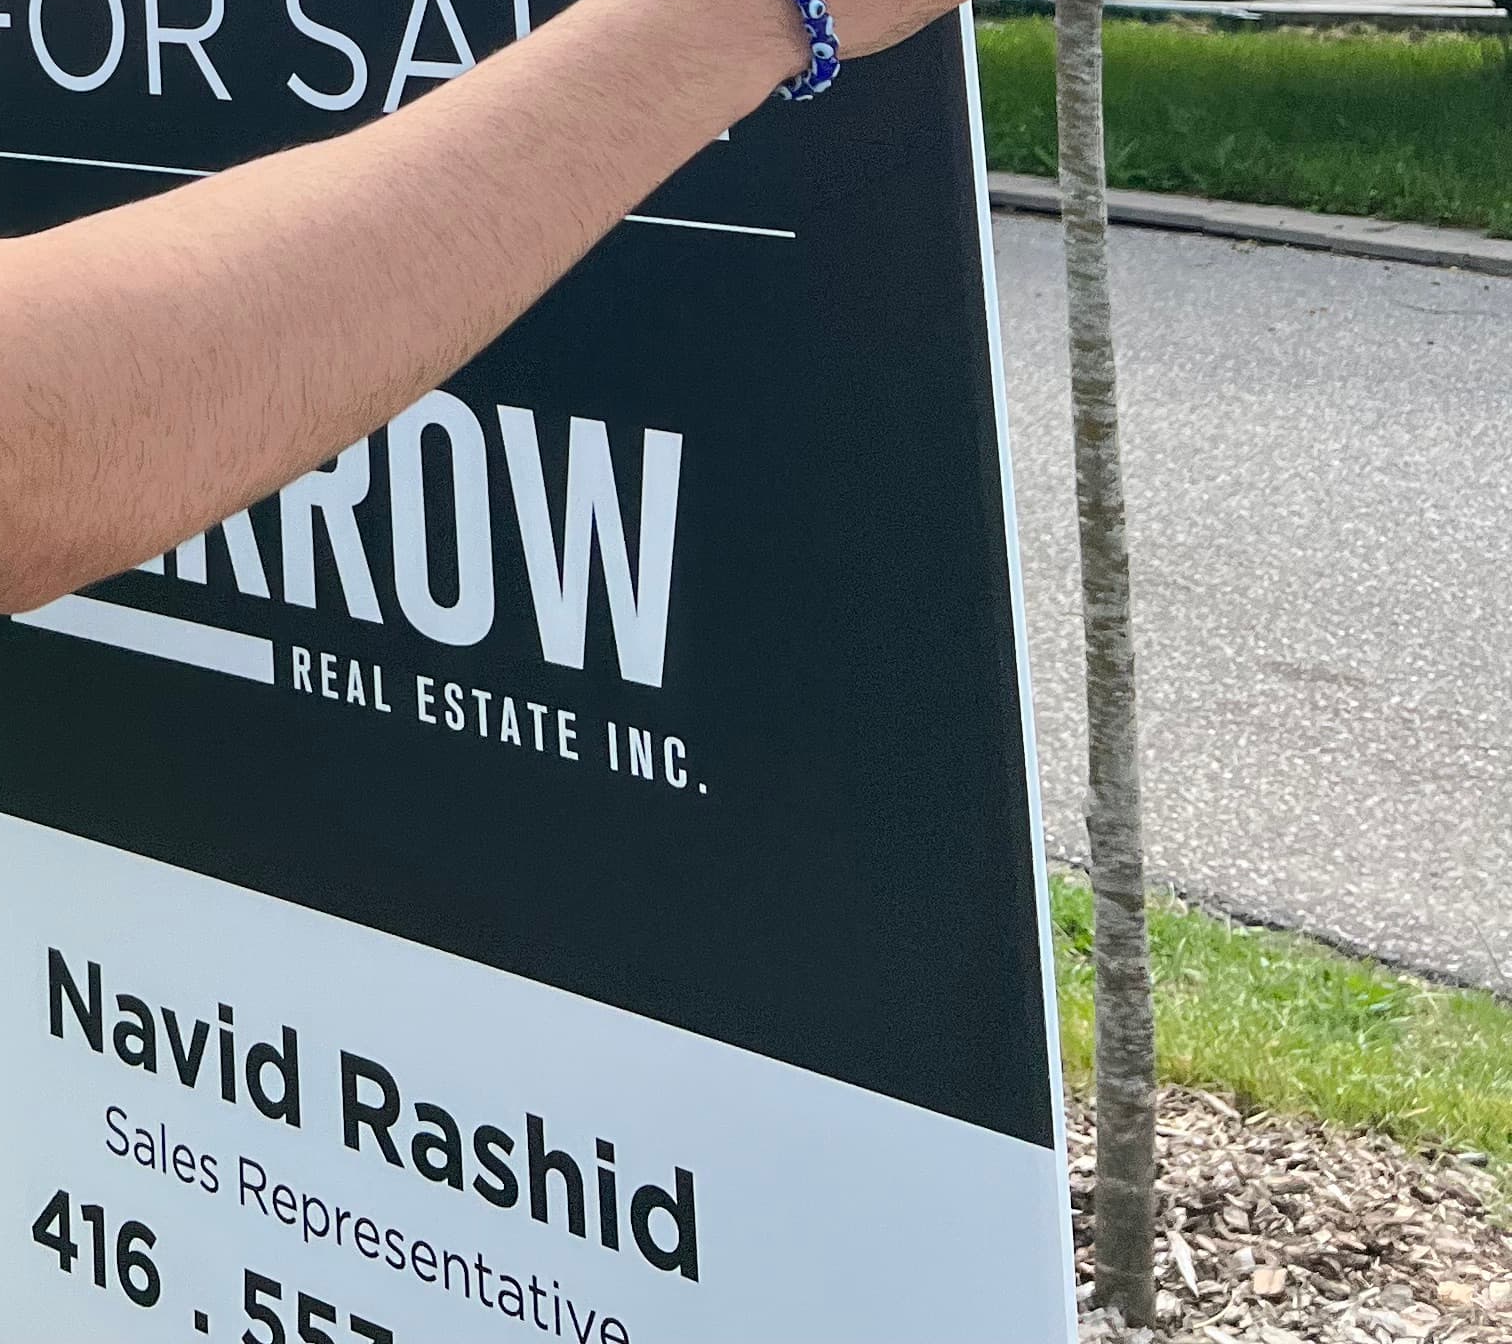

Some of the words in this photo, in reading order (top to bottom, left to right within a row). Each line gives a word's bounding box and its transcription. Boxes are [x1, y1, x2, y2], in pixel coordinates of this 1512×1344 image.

[292, 645, 392, 713] REAL
[416, 675, 580, 761] ESTATE
[607, 721, 708, 795] INC.
[48, 946, 301, 1129] Navid
[340, 1049, 699, 1283] Rashid
[31, 1188, 161, 1308] 416
[106, 1106, 219, 1194] Sales
[239, 1155, 630, 1344] Representative
